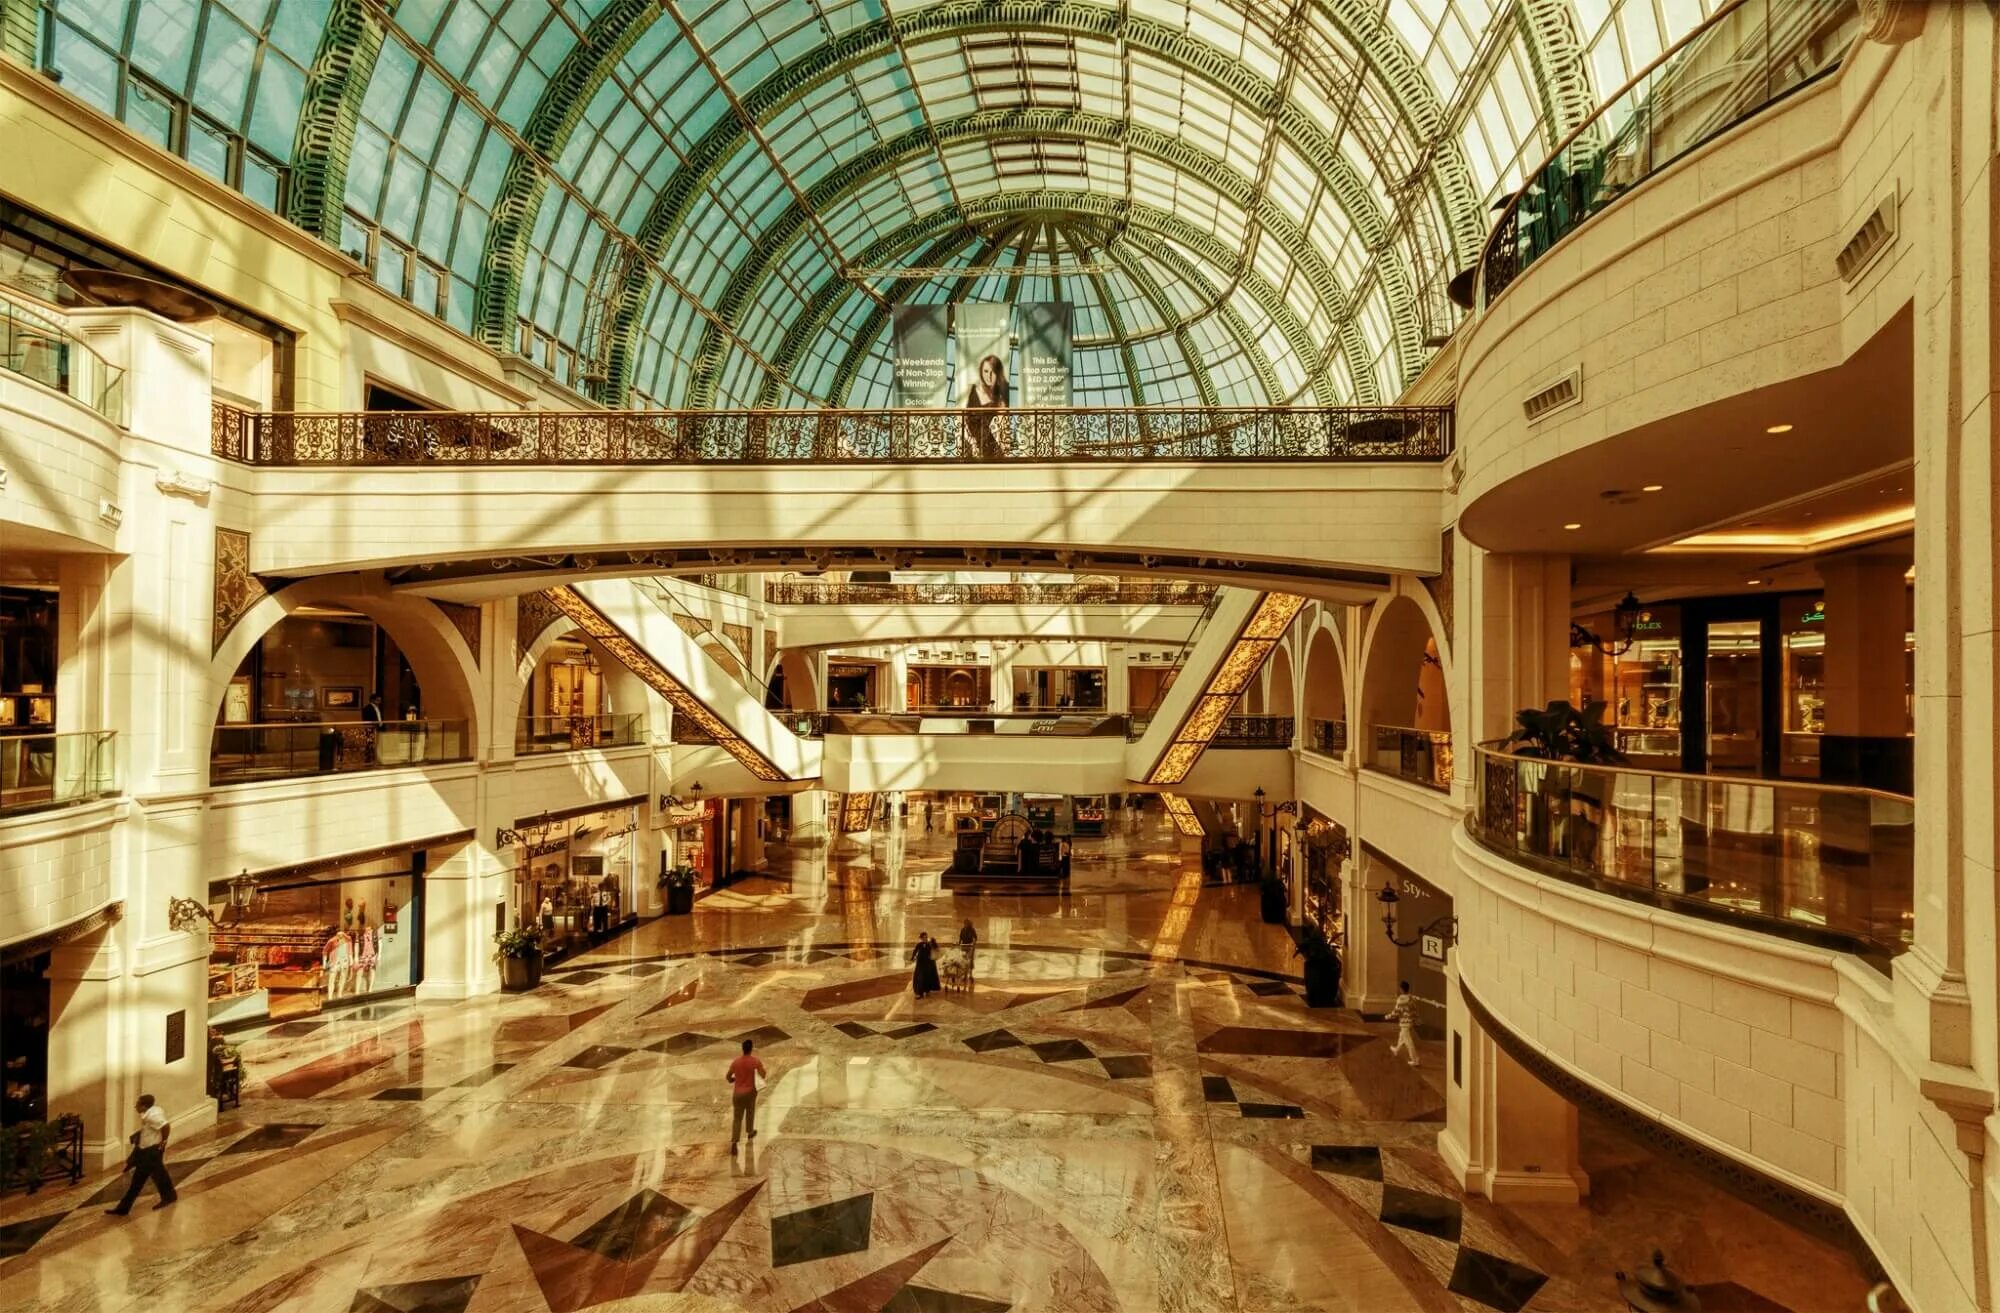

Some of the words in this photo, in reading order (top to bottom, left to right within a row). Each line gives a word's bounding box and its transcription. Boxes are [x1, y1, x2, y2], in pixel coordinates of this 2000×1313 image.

[895, 358, 900, 366] 3
[902, 358, 944, 366] Weekends
[906, 369, 944, 378] Non-Stop
[1632, 622, 1662, 630] OLEX
[1427, 940, 1438, 954] R
